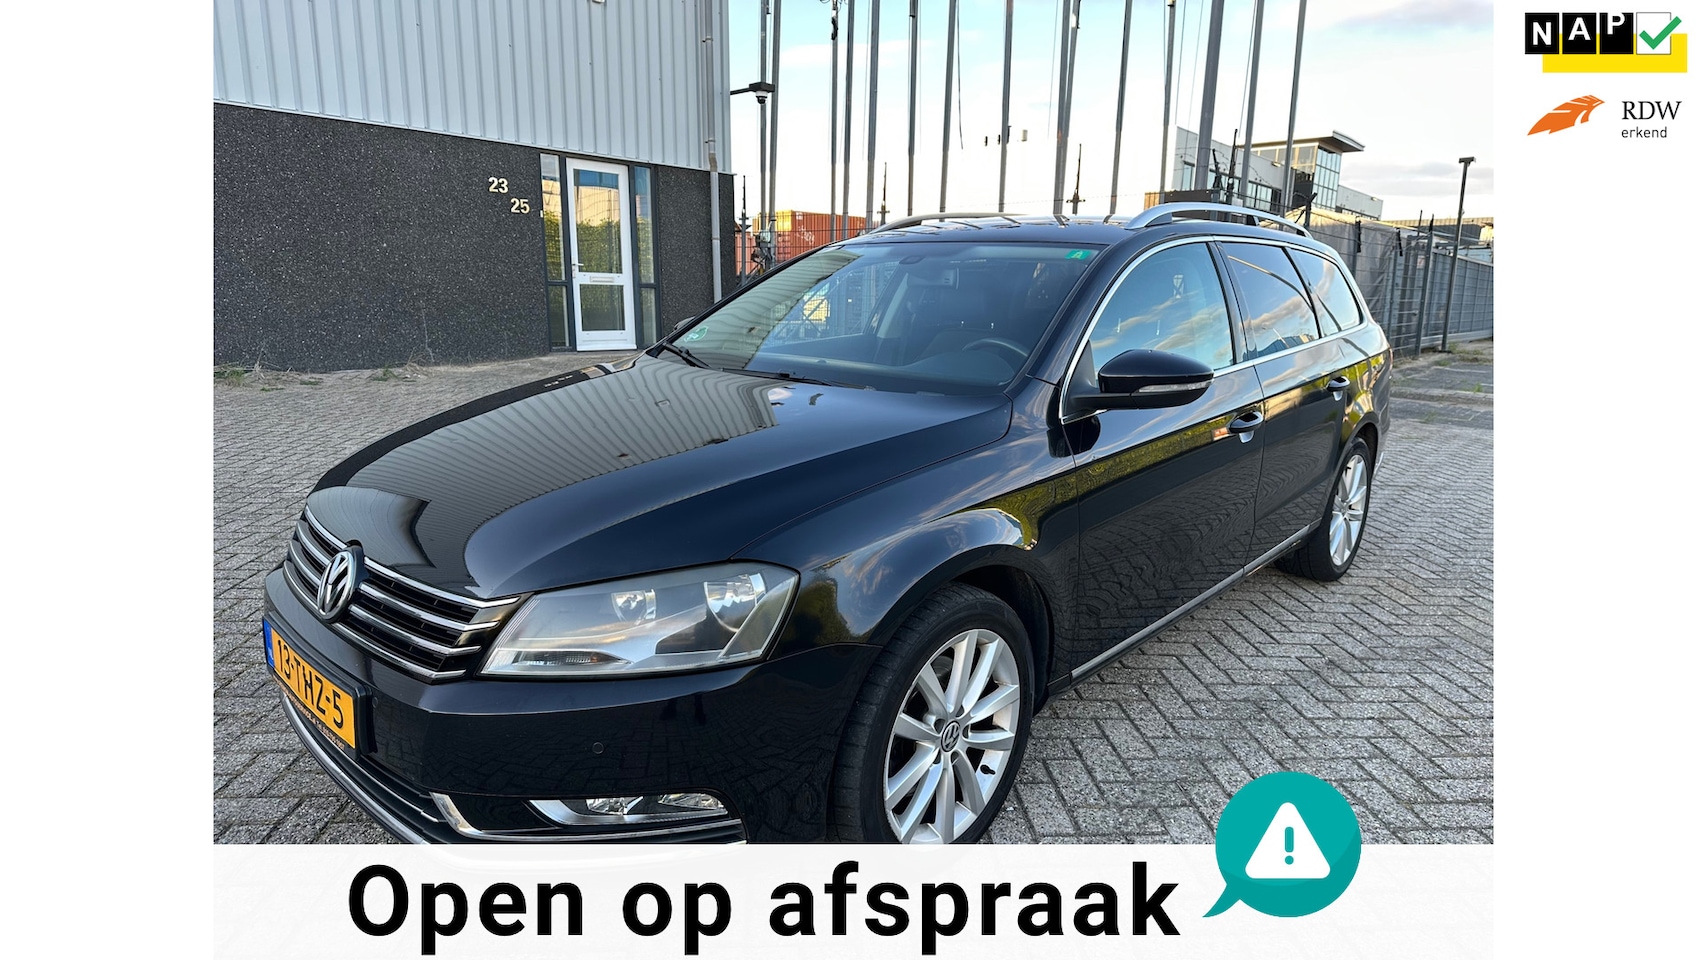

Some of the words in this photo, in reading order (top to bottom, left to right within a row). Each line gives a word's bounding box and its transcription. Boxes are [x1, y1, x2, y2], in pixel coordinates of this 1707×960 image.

[488, 176, 509, 194] 23
[510, 197, 530, 214] 25
[277, 639, 344, 729] 13-THZ-5
